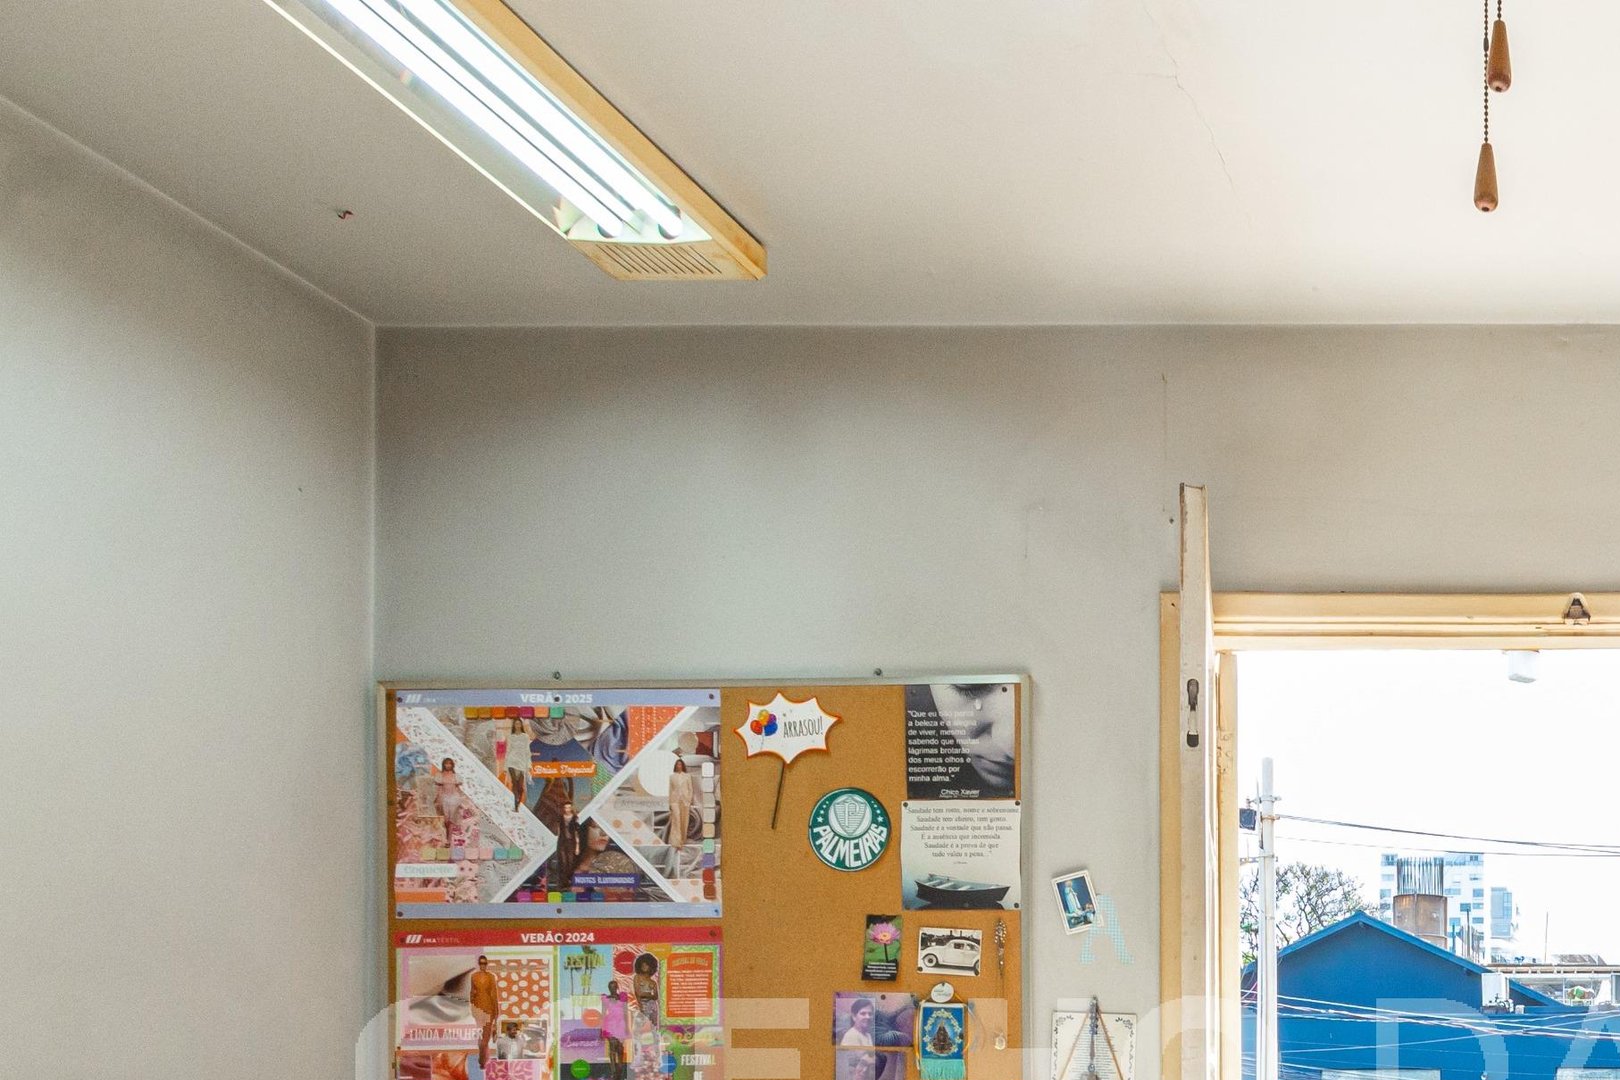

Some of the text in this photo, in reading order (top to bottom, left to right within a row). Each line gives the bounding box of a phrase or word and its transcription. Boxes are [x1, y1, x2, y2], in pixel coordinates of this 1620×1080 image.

[520, 692, 593, 703] VERÃO 2025
[783, 716, 823, 738] ARRASOU!
[813, 824, 888, 867] PALMEIRAS
[521, 931, 595, 943] VERÃO 2024
[409, 1028, 440, 1040] LINDA
